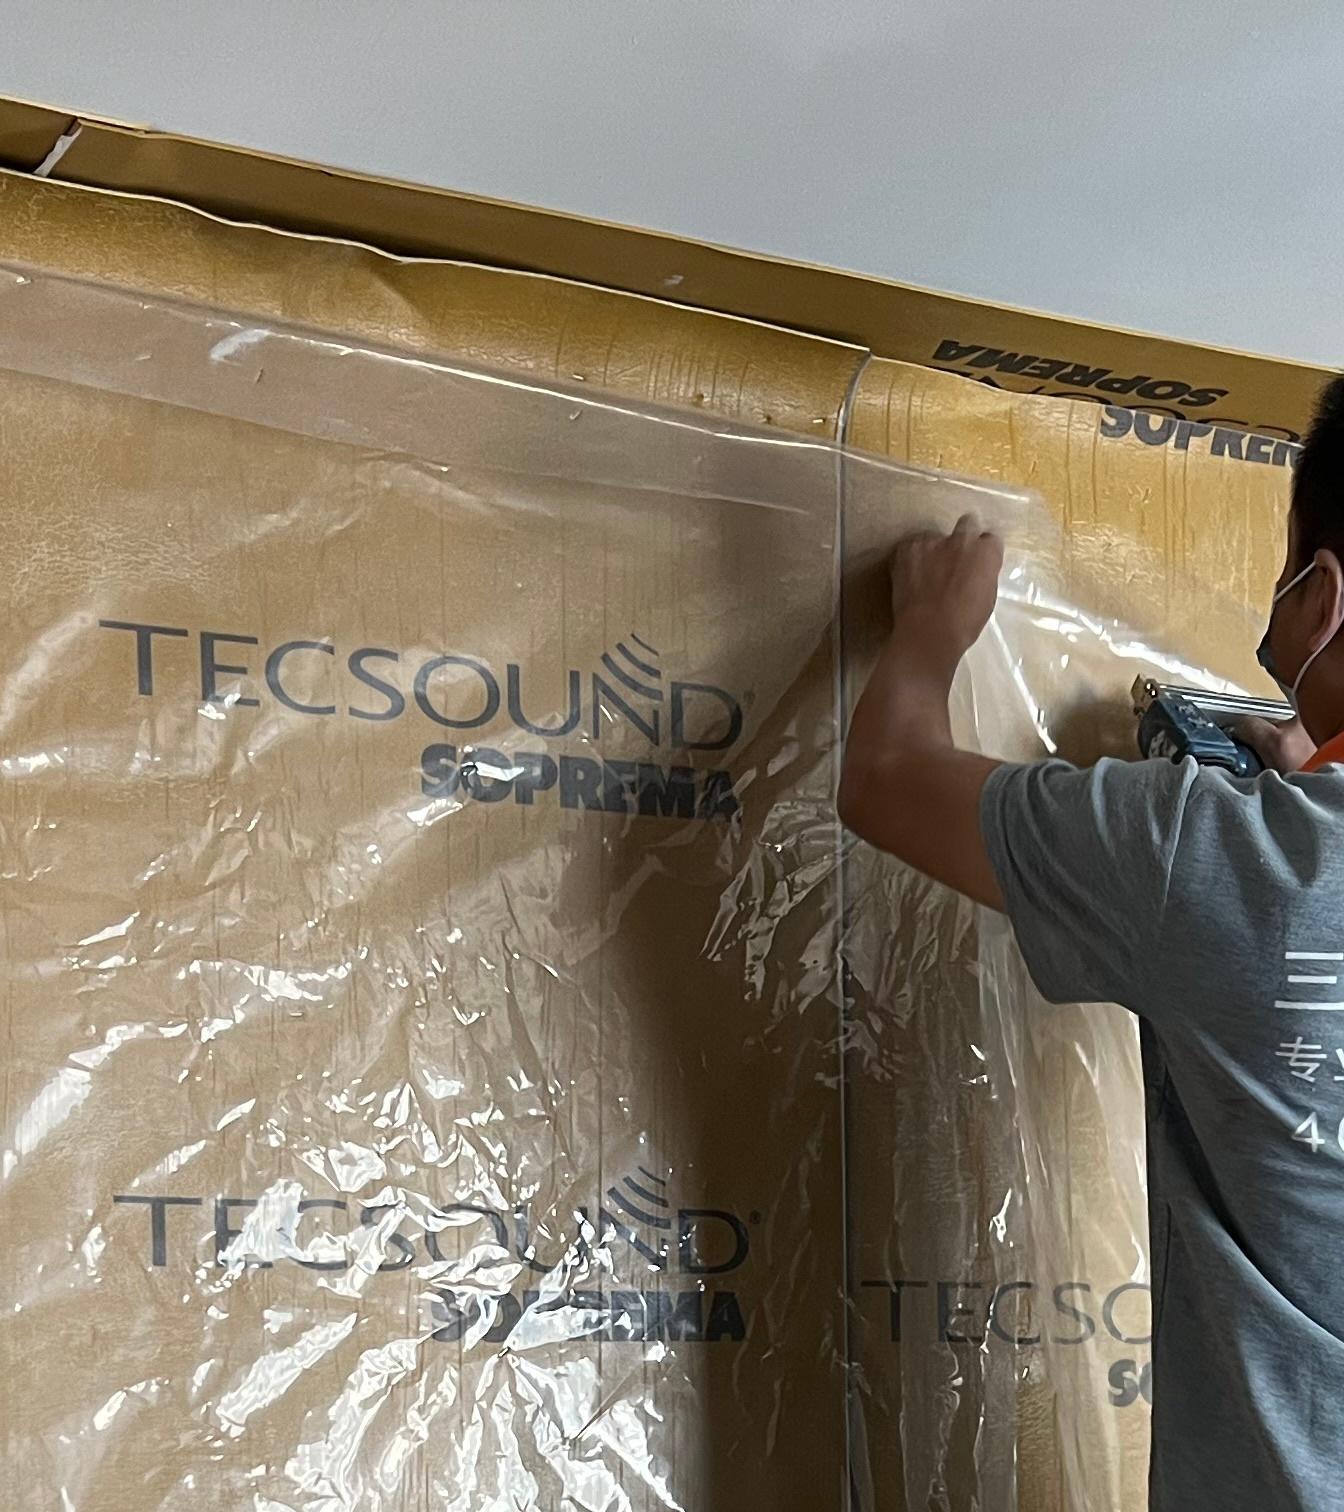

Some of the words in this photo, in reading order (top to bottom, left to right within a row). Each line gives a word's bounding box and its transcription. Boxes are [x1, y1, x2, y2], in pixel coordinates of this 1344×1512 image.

[932, 339, 1229, 407] SOPREMA
[98, 619, 742, 751] TECSOUND
[420, 744, 741, 819] SOPREMA
